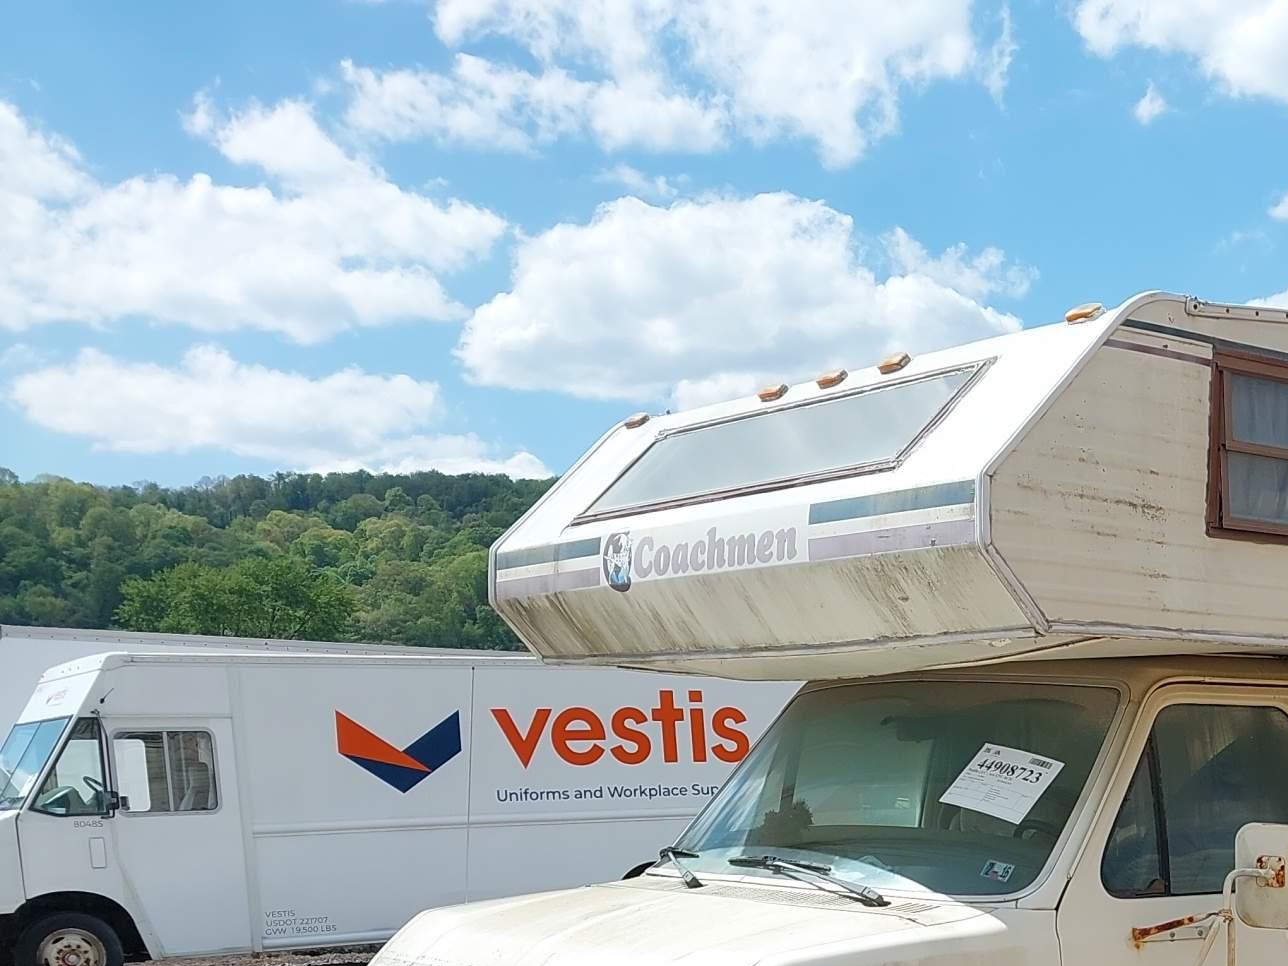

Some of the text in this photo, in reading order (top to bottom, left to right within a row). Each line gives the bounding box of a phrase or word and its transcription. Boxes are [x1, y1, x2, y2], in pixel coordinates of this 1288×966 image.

[633, 526, 797, 579] Coachmen
[491, 689, 749, 769] vestis
[977, 758, 1043, 784] 44908723
[496, 788, 571, 802] Uniforms
[573, 786, 604, 800] and
[607, 784, 688, 800] Workplace
[264, 909, 296, 918] VESTIS
[265, 918, 297, 927] USDOT
